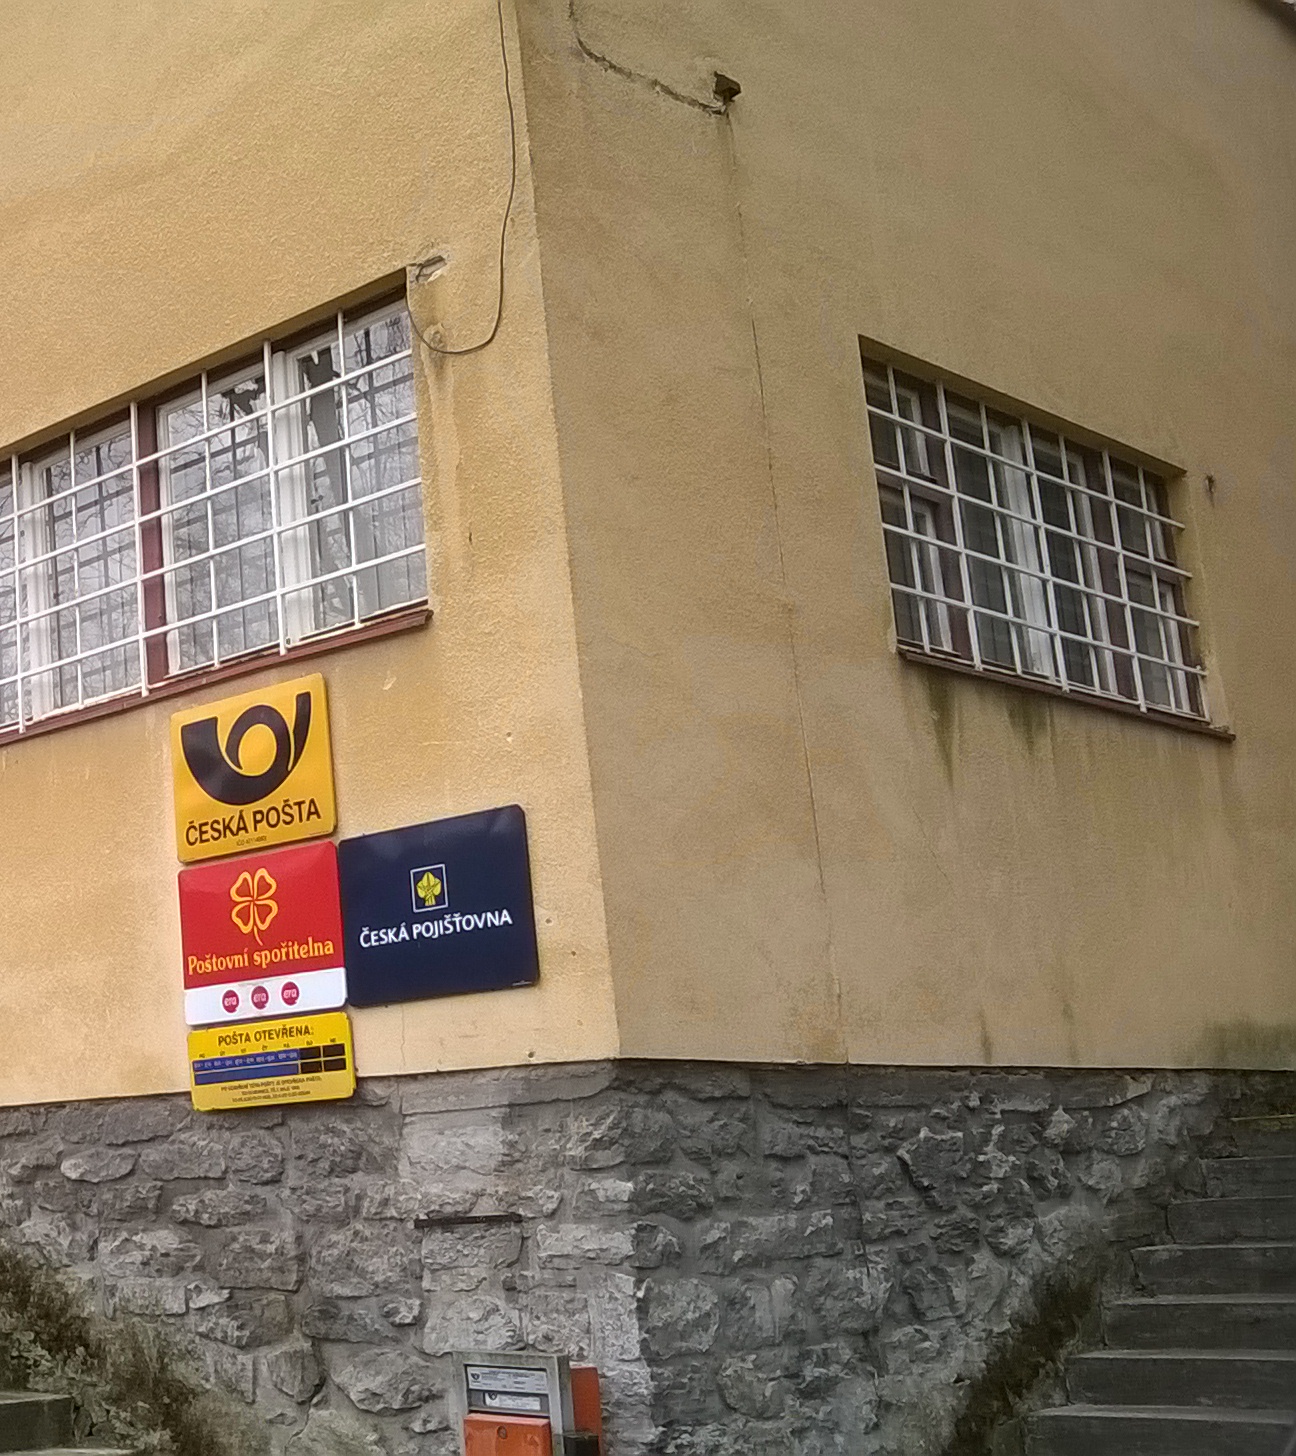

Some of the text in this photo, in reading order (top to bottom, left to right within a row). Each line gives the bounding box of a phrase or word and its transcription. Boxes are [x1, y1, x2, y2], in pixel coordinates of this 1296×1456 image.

[185, 797, 321, 847] ČESKÁ POŠTA
[359, 908, 512, 948] ČESKÁ POJIŠŤOVNA
[188, 936, 335, 975] Poštovní spořitelna
[224, 996, 237, 1007] era
[253, 992, 267, 1003] era
[283, 988, 297, 999] era
[218, 1024, 314, 1047] POŠTA OTEVŘENA:
